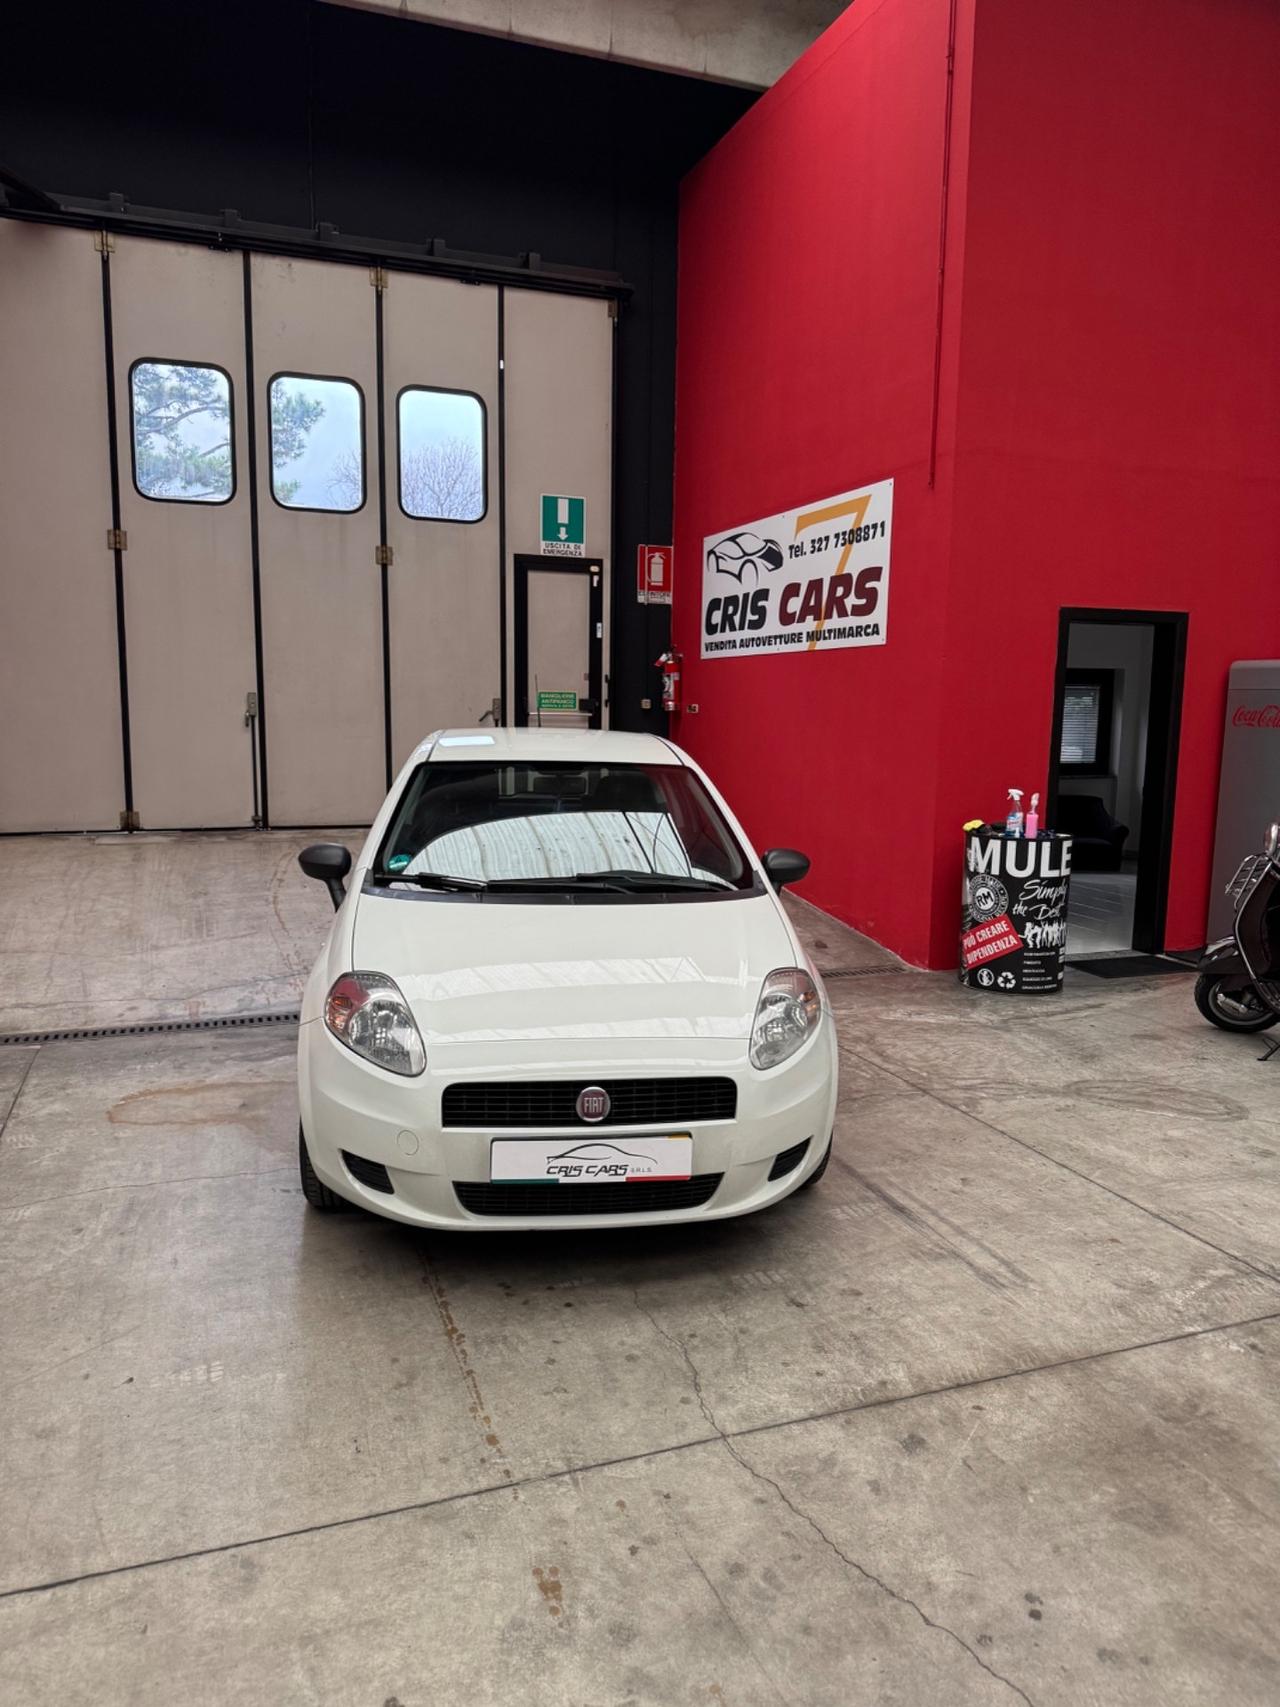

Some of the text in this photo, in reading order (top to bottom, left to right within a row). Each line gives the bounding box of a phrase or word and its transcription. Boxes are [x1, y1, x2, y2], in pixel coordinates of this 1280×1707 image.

[788, 521, 886, 559] Tel. 327 7308871
[543, 548, 582, 556] EMERGENZA
[705, 566, 883, 636] CRIS CARS
[705, 623, 880, 652] VENDITA AUTOVETTURE MULTIMARCA
[969, 837, 1073, 878] MULE
[976, 891, 994, 908] RM
[1012, 901, 1028, 916] the
[975, 920, 1010, 943] CREARE
[966, 934, 1018, 964] DIPENDENZA
[584, 1097, 604, 1113] FIAT
[546, 1165, 583, 1177] CRIS
[585, 1164, 630, 1177] CARS
